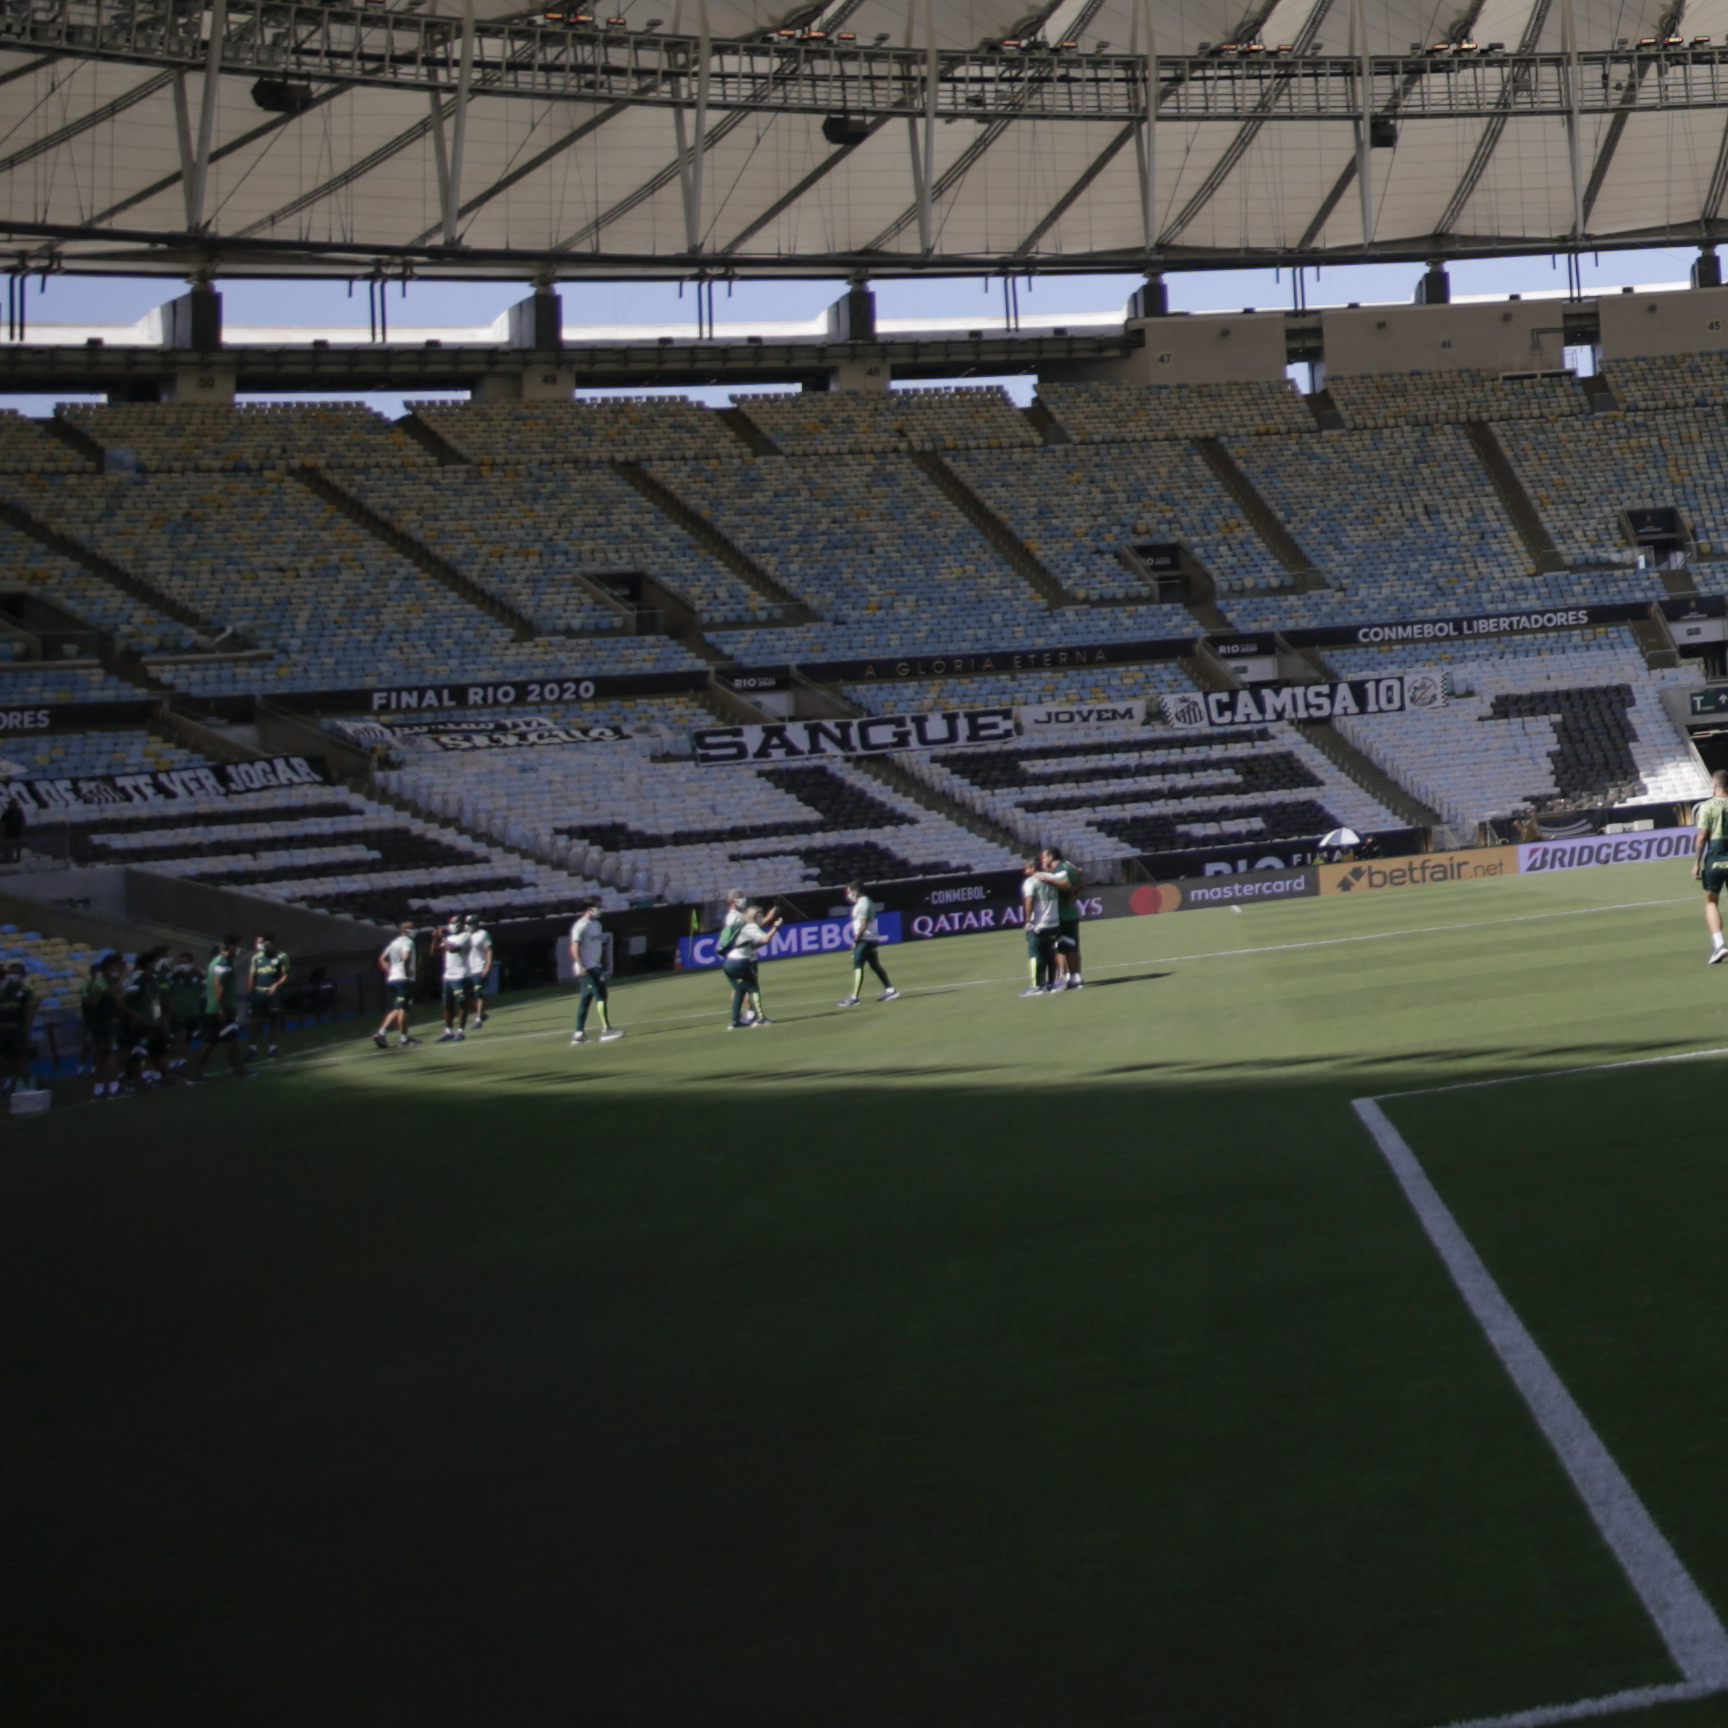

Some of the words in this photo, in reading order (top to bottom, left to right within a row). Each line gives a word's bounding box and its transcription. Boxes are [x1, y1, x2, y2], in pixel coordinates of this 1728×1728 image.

[1358, 623, 1459, 643] CONMEBOL
[1463, 610, 1588, 634] LIBERTADORES
[864, 664, 878, 678] A
[1013, 648, 1107, 670] ETERNA
[1219, 644, 1239, 654] RIO
[372, 688, 456, 711] FINAL
[468, 684, 517, 705] RIO
[527, 680, 596, 701] 2020
[733, 677, 756, 689] RIO
[1207, 683, 1360, 726] CAMISA
[1364, 676, 1404, 713] 10
[1692, 696, 1704, 712] T
[694, 707, 1016, 763] SANGUE
[34, 779, 81, 809] DE
[114, 774, 160, 803] TE
[159, 768, 227, 799] VER
[225, 757, 324, 792] JOGAR
[1525, 829, 1699, 872] BRIDGESTON
[1190, 874, 1306, 902] mastercard
[912, 909, 996, 938] QATAR
[1001, 897, 1104, 926] AIYS
